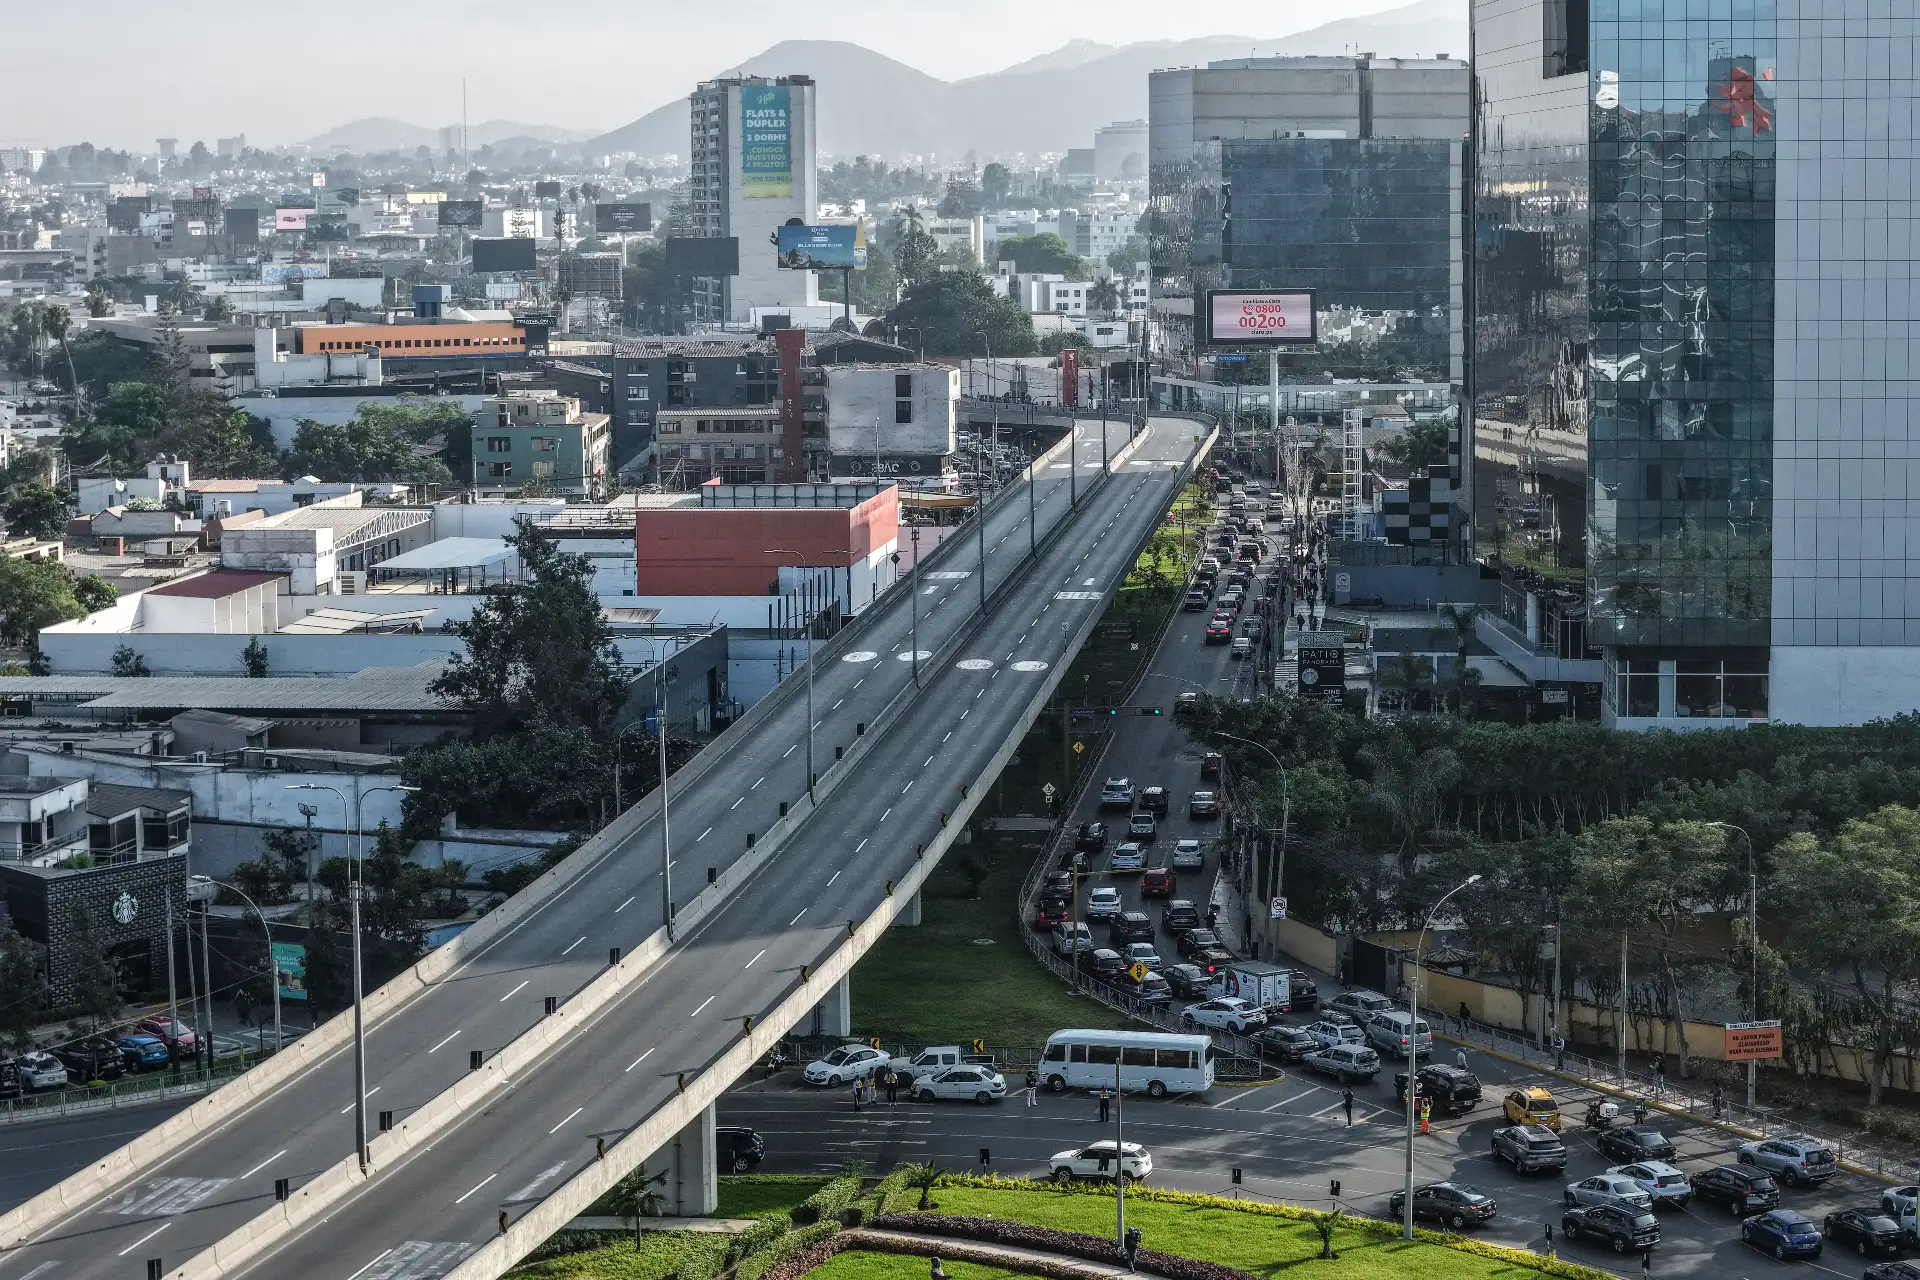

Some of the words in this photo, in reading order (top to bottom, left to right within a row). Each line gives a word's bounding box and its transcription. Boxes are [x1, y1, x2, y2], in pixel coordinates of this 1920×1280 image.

[746, 109, 776, 118] FLATS
[778, 108, 786, 118] &
[746, 117, 786, 128] DÚPLEX
[746, 134, 752, 142] 3
[754, 133, 787, 141] DORMS
[1255, 305, 1280, 313] 0800
[1239, 314, 1285, 328] 00200
[1055, 591, 1105, 600] BUS
[1758, 1032, 1775, 1040] PRADO
[1737, 1040, 1770, 1048] CLAUSURADO
